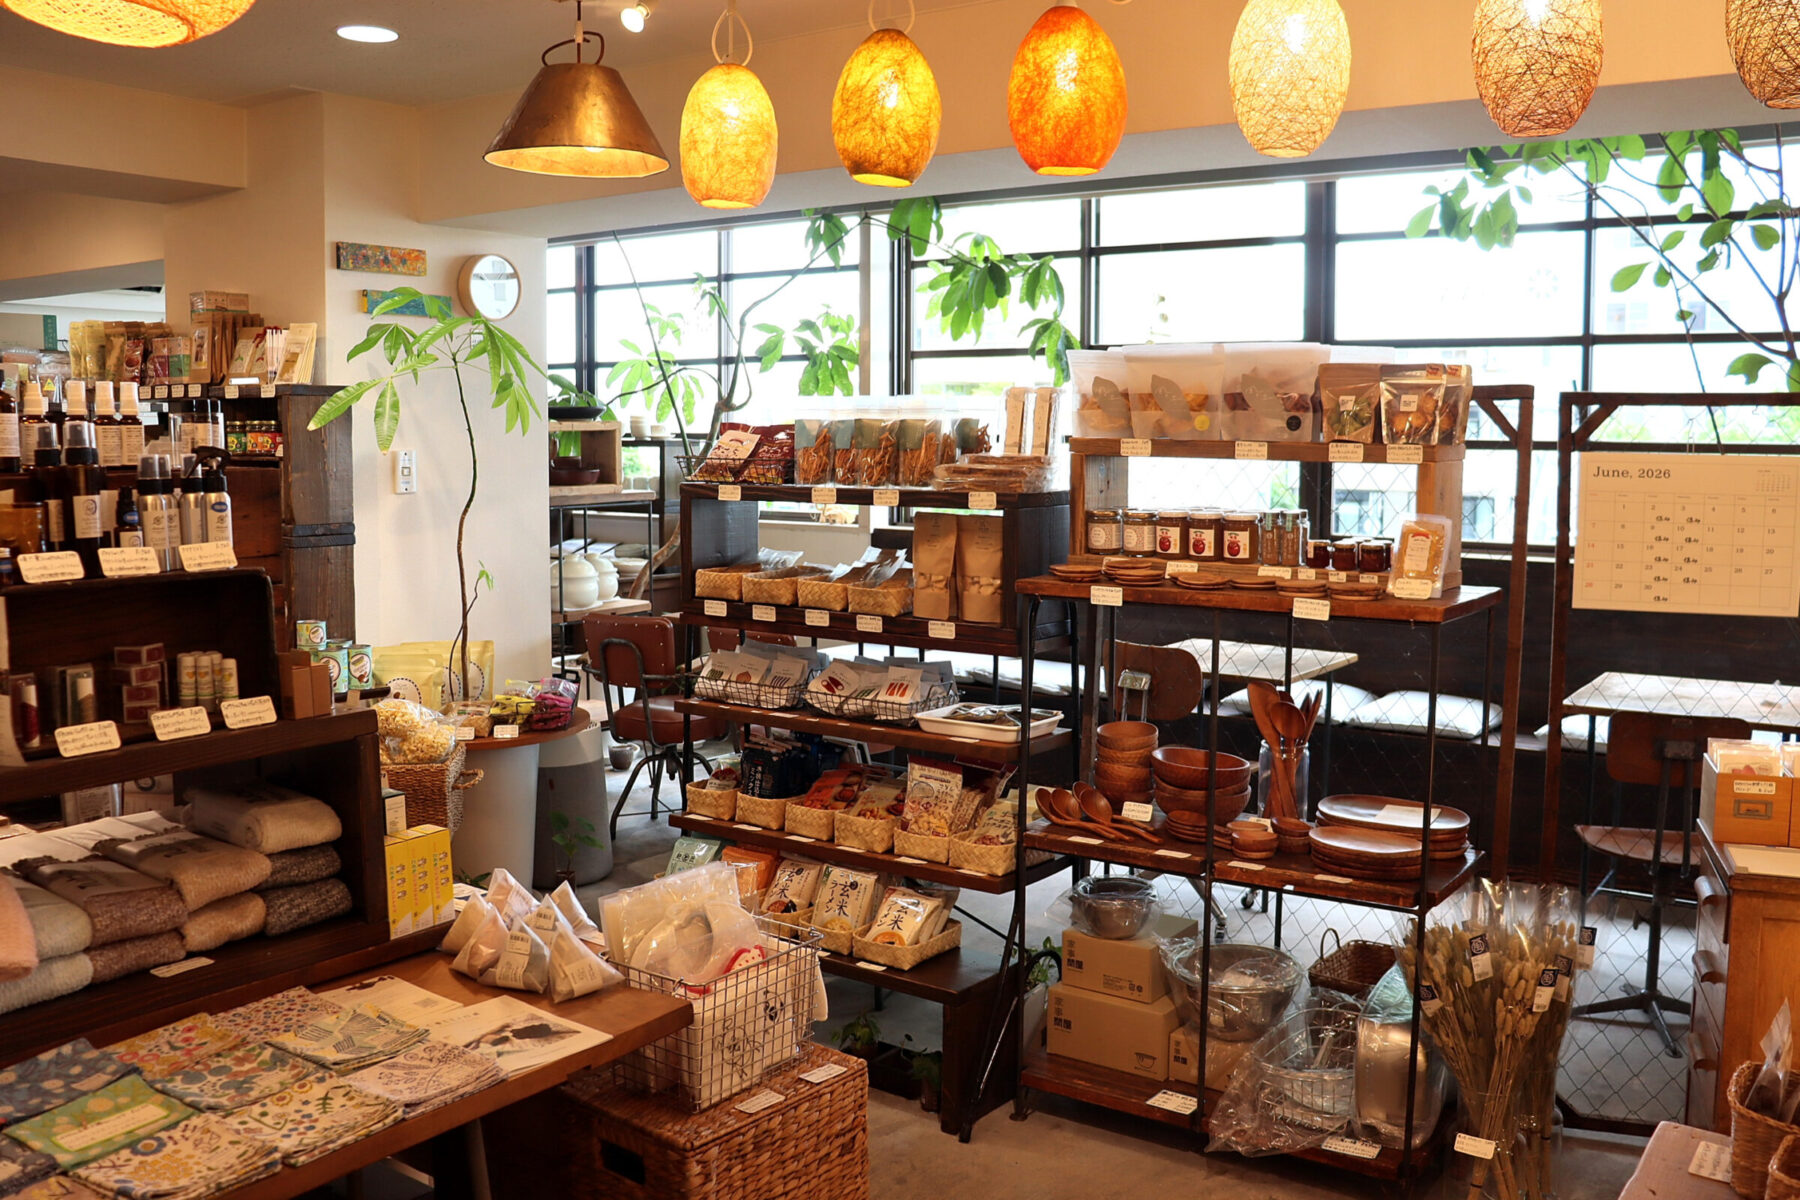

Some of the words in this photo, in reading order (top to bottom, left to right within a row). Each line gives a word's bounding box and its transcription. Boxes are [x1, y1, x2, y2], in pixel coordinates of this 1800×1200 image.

[1592, 466, 1633, 480] June,
[1638, 468, 1671, 480] 2026
[777, 868, 797, 899] 玄米
[824, 879, 839, 913] ラーメン
[836, 880, 852, 917] 玄米
